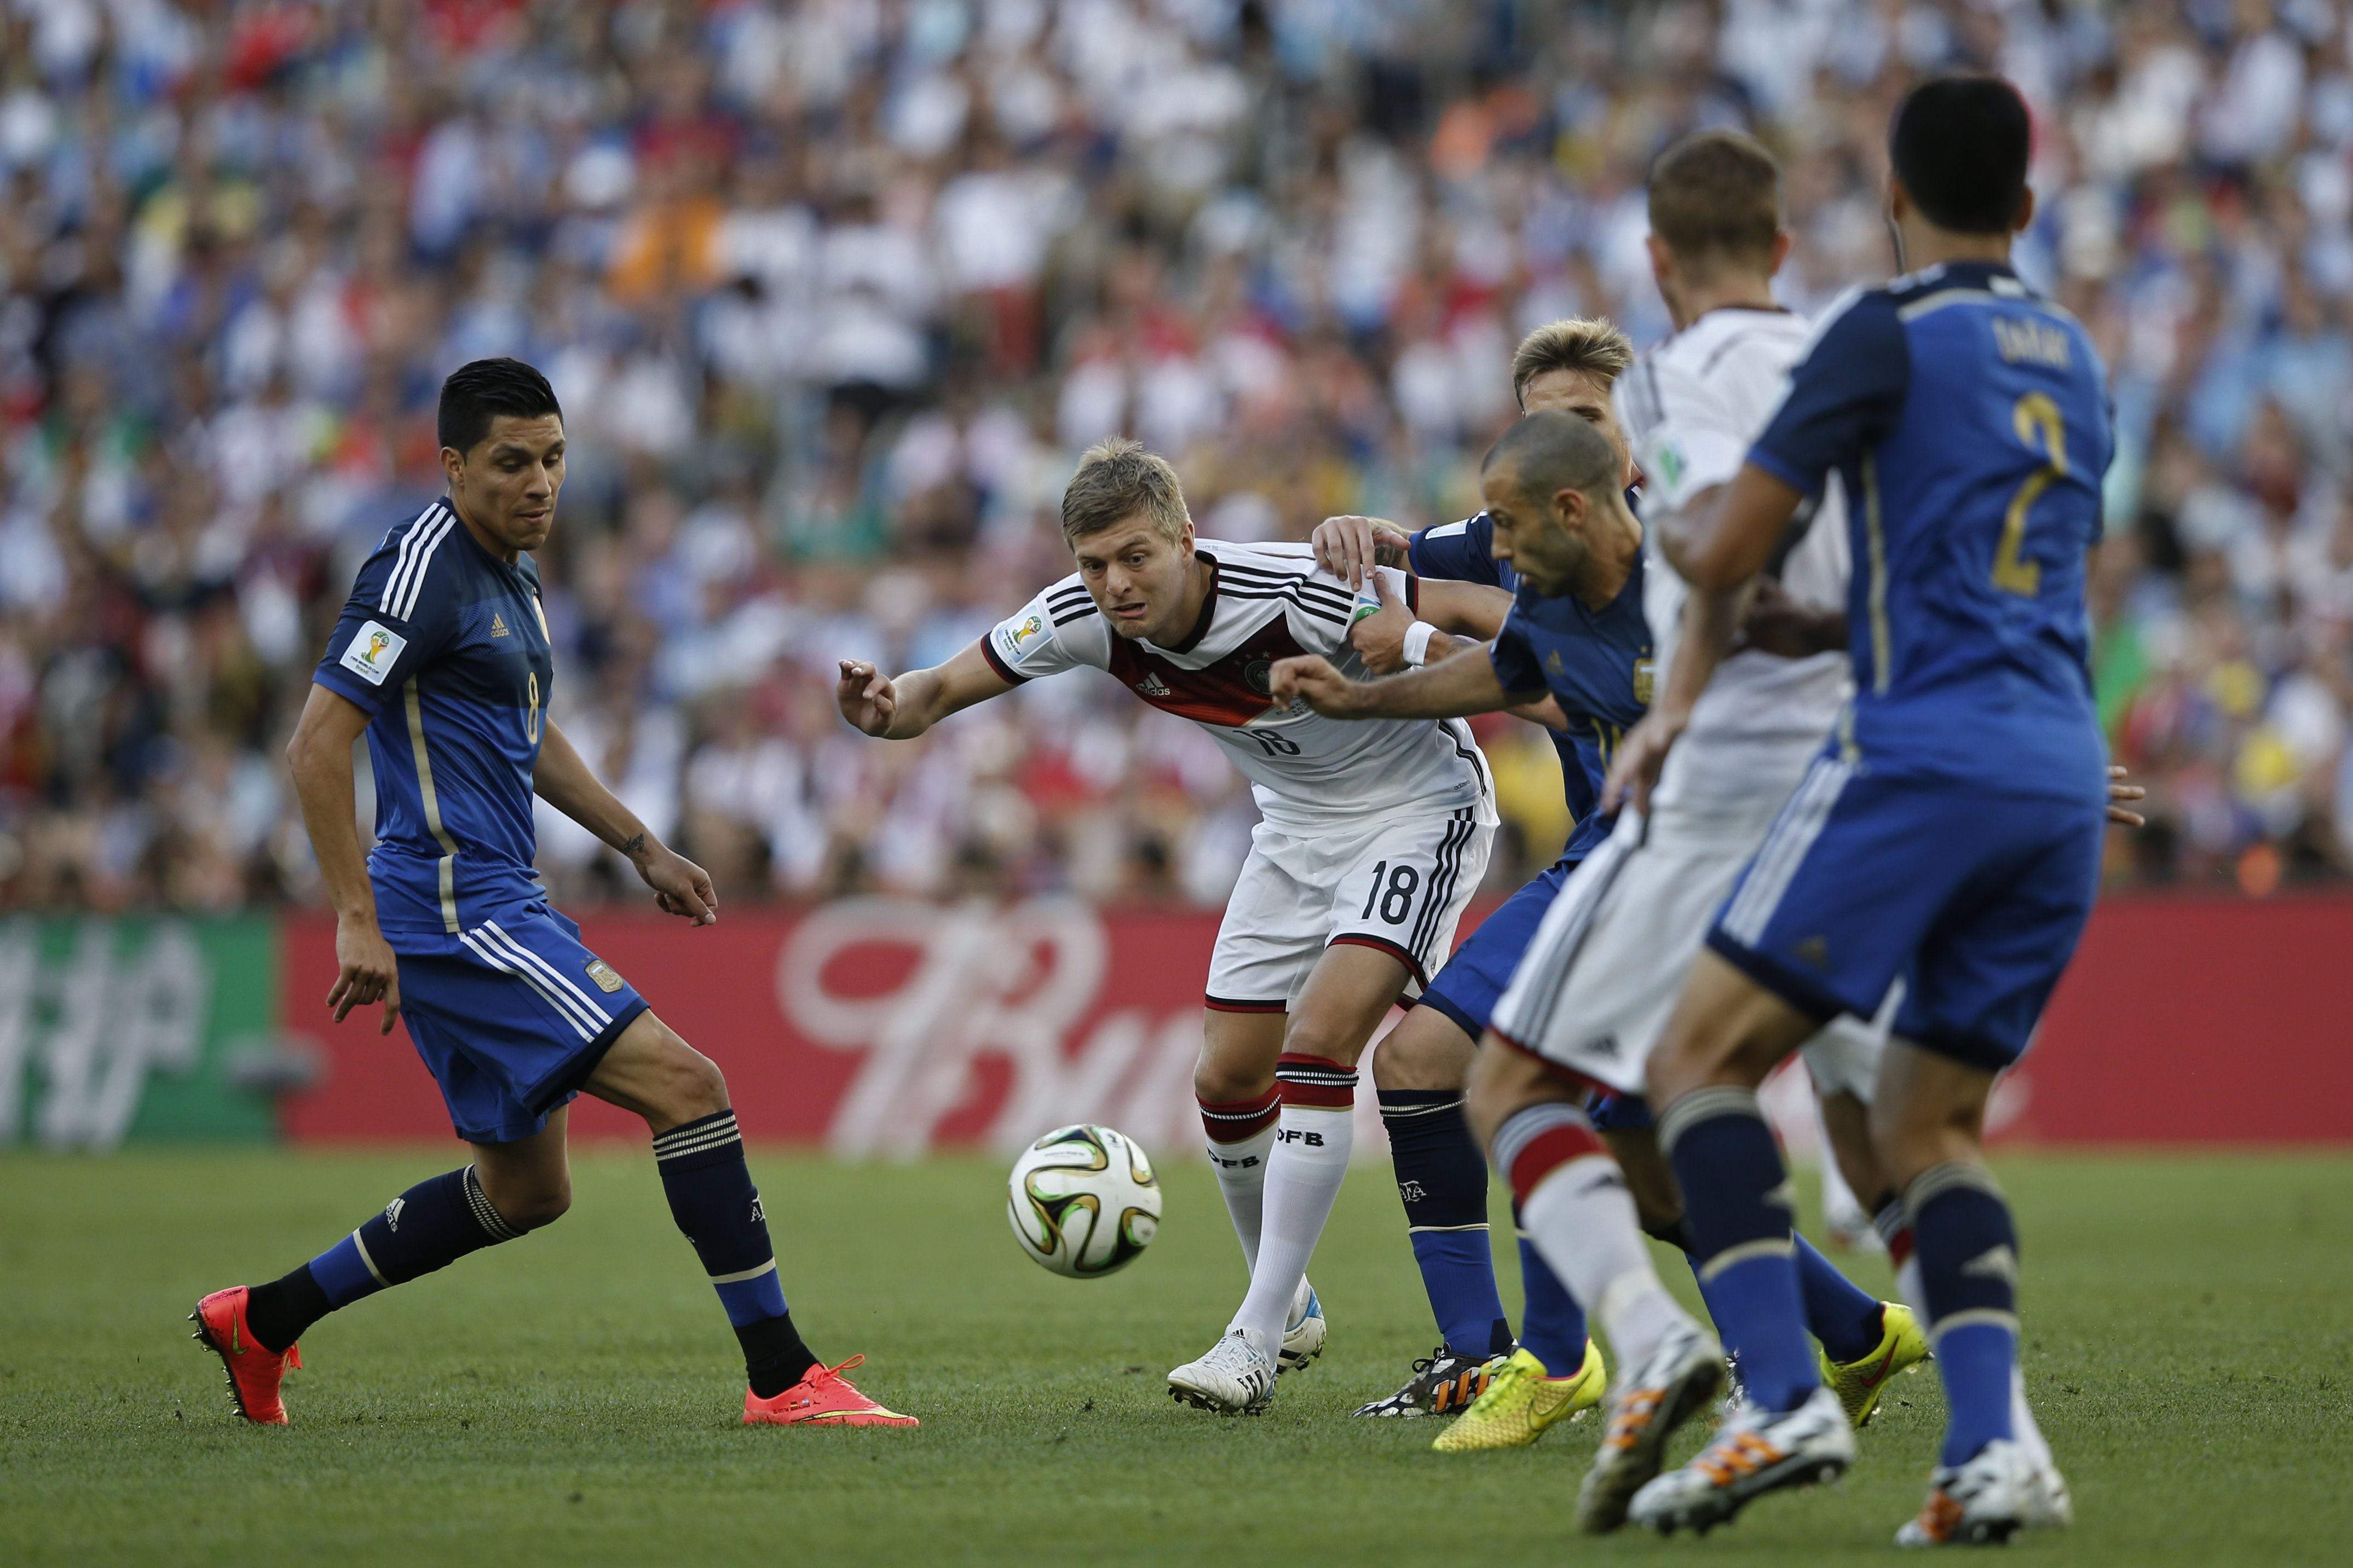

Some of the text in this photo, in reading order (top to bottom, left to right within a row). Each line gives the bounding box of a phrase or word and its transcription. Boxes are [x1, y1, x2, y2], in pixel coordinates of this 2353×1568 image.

[1993, 391, 2068, 598] 2
[359, 659, 372, 670] WORLD
[528, 672, 539, 744] 8
[1232, 728, 1301, 756] 18
[1362, 860, 1419, 925] 18
[1277, 1128, 1324, 1147] DFB
[1207, 1147, 1260, 1168] DFB
